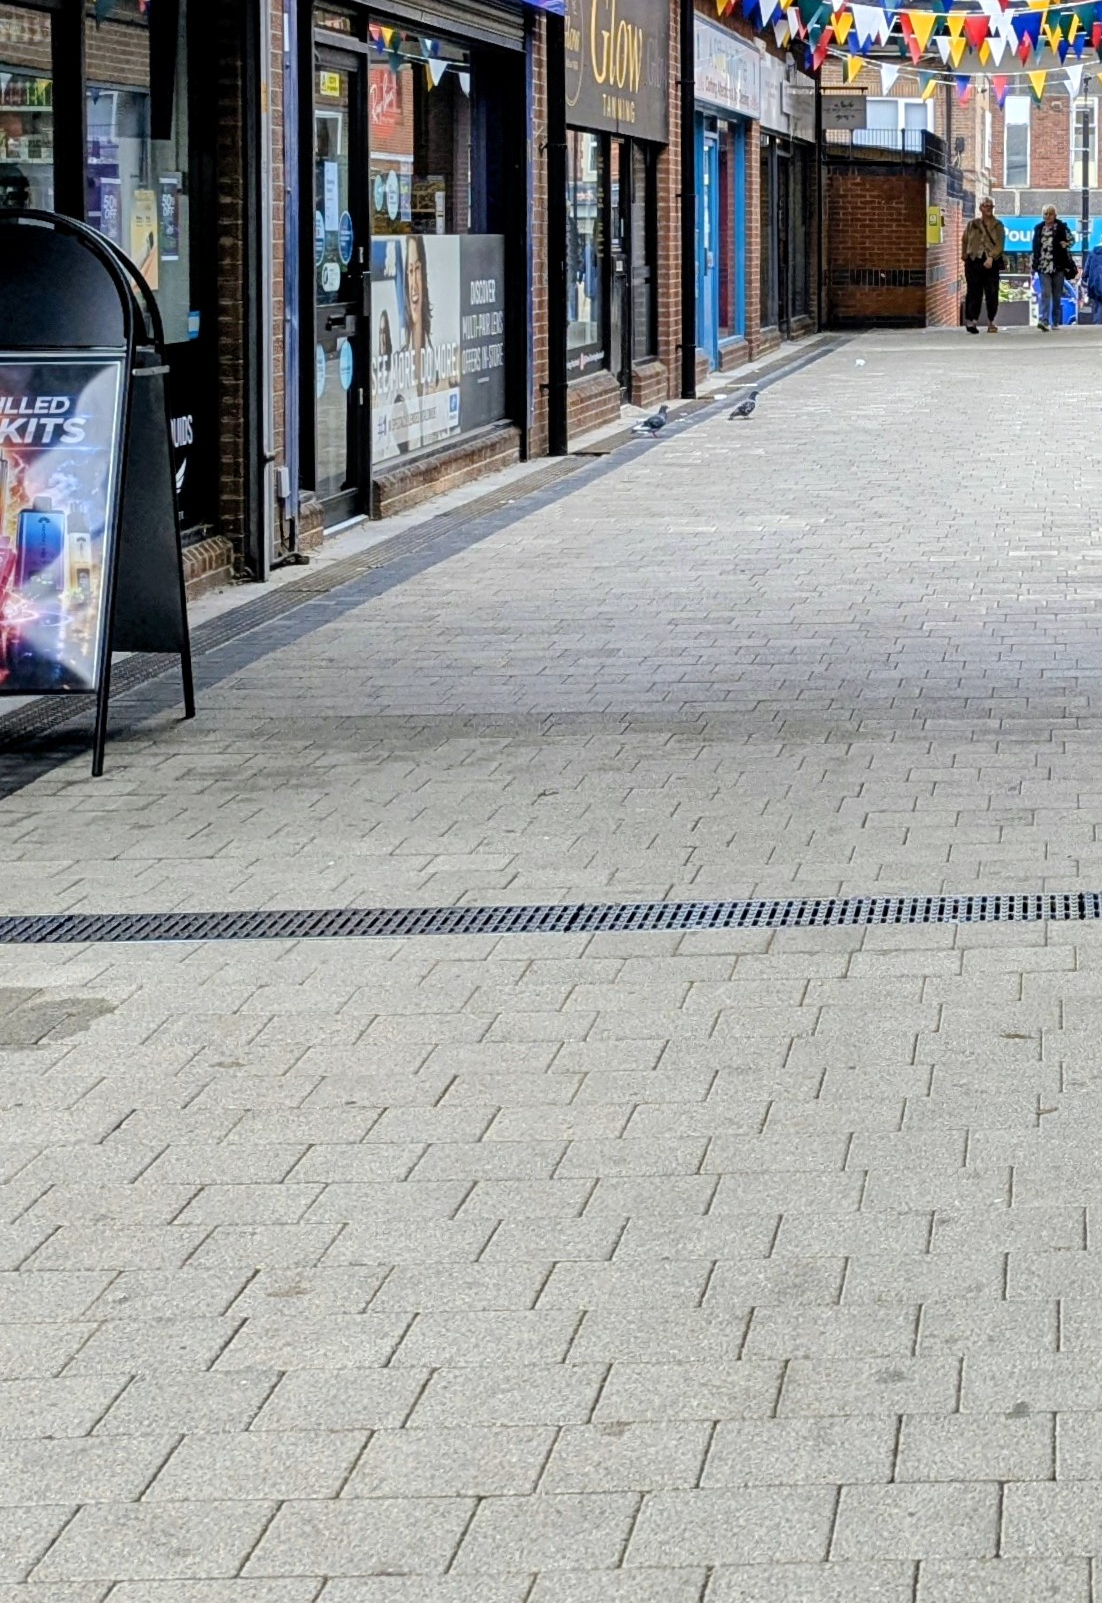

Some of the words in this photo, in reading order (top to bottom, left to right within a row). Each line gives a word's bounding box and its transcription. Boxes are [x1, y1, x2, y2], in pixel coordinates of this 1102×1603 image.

[602, 93, 636, 124] TANNING
[470, 279, 496, 306] DISCOVER
[371, 355, 388, 396] SEE
[420, 347, 432, 384] DO
[462, 346, 481, 375] OFFERS
[0, 418, 87, 444] KITS
